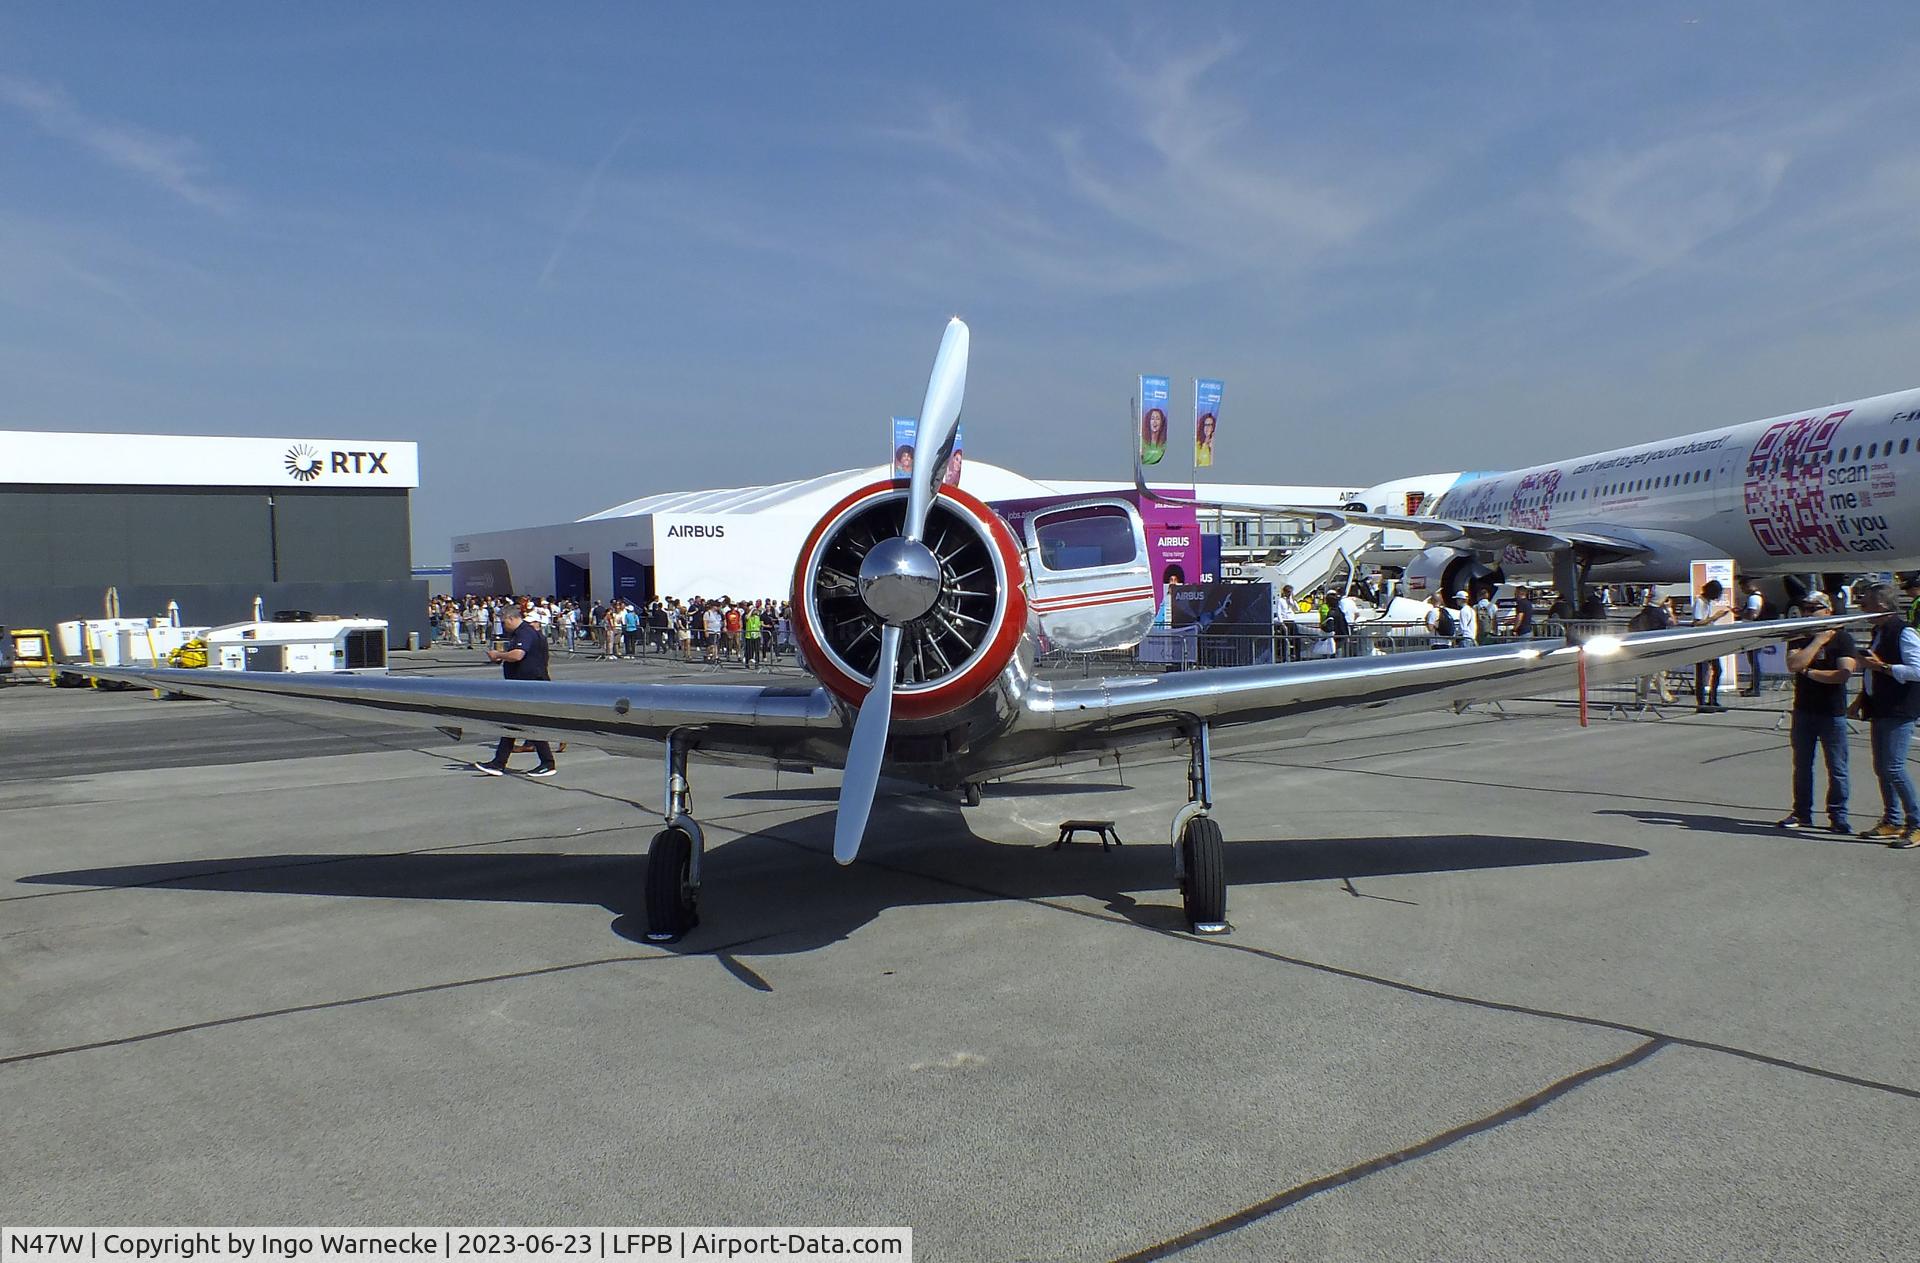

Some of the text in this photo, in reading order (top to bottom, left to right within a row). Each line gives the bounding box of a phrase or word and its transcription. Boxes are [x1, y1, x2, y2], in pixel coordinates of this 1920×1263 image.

[331, 451, 388, 474] RTX
[1642, 448, 1668, 465] you
[1667, 445, 1684, 459] on
[1828, 464, 1868, 485] scan
[1830, 492, 1857, 510] me
[667, 525, 724, 537] AIRBUS
[1834, 514, 1888, 537] if you
[1158, 536, 1189, 547] AIRBUS
[1849, 533, 1895, 553] can!
[1226, 567, 1242, 576] TLD
[1175, 591, 1204, 601] AIRBUS
